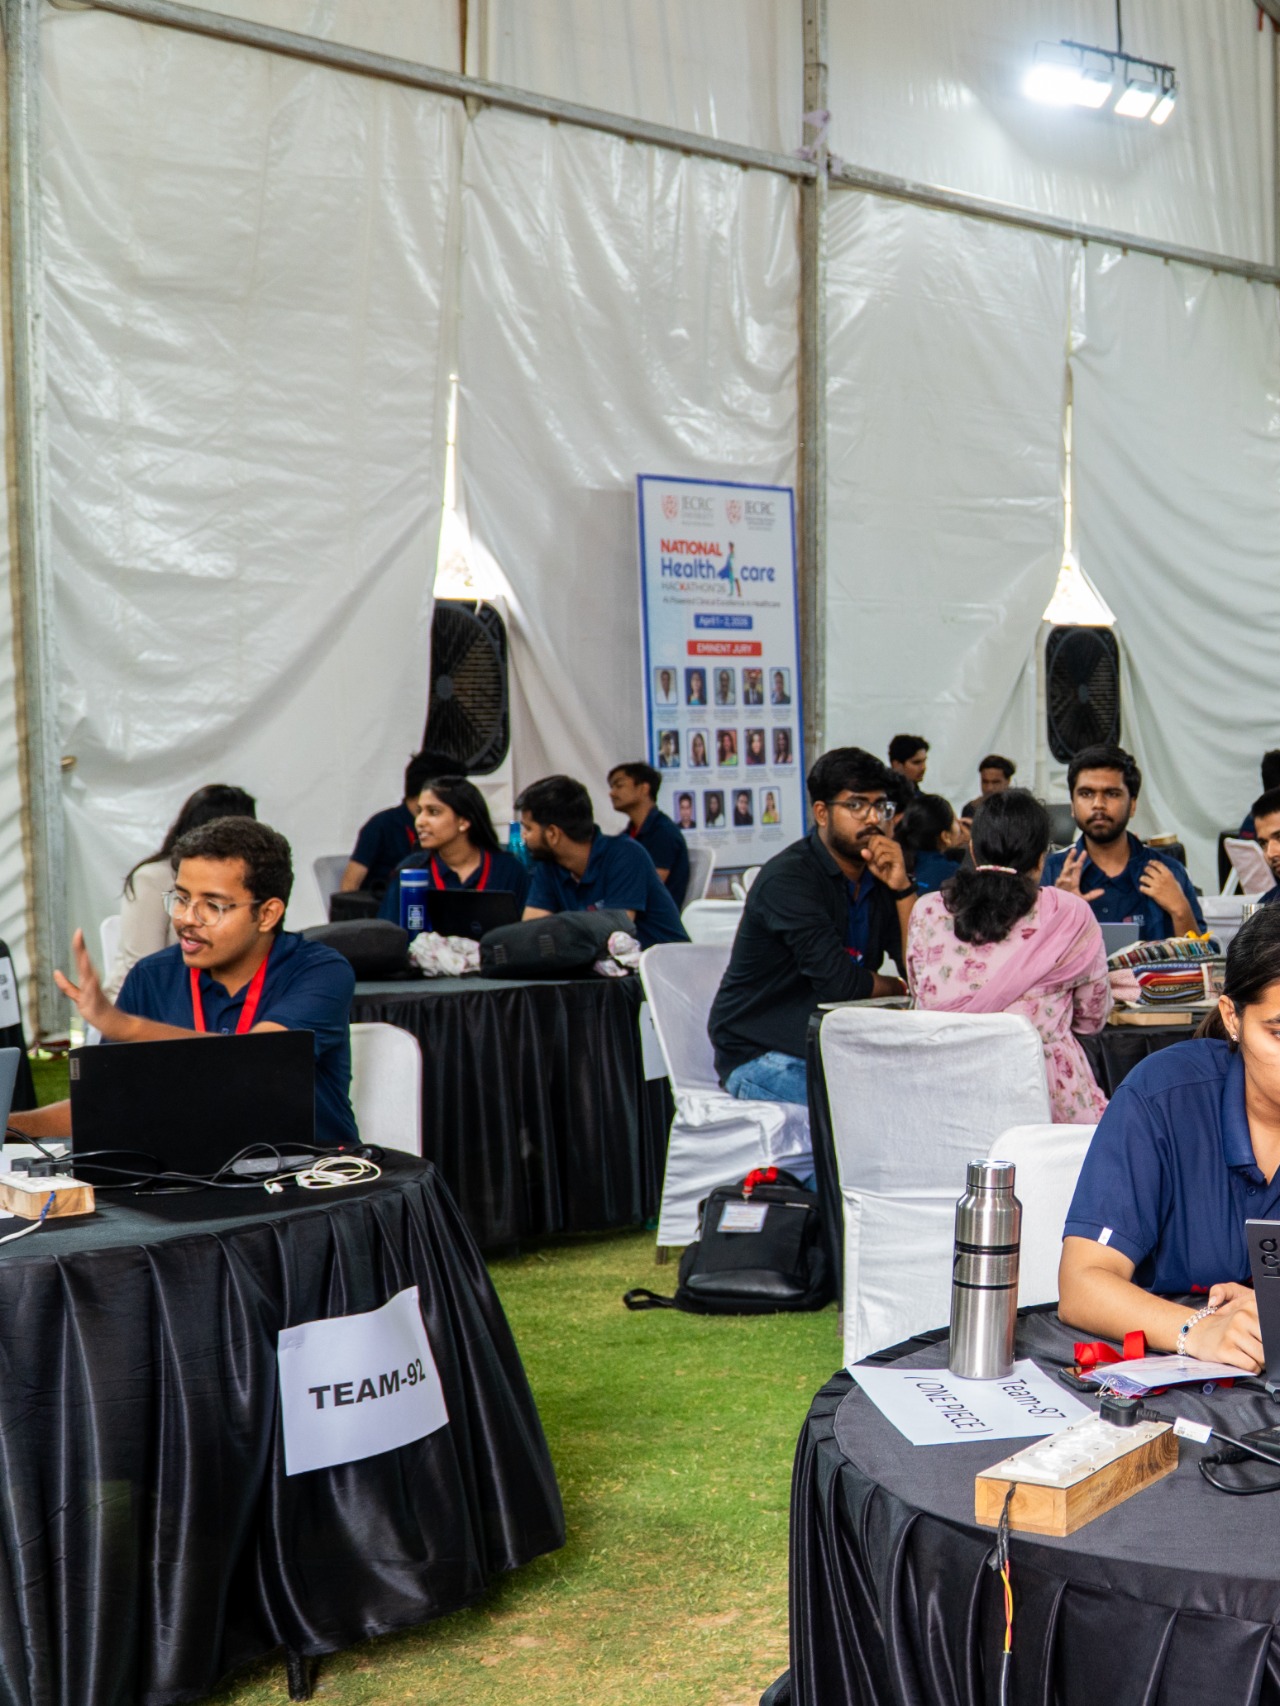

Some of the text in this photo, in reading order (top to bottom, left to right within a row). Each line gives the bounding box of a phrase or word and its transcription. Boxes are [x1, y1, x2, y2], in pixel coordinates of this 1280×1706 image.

[660, 539, 723, 557] NATIONAL
[660, 557, 775, 583] Health care
[308, 1358, 426, 1410] TEAM-92
[997, 1378, 1067, 1419] Team-87
